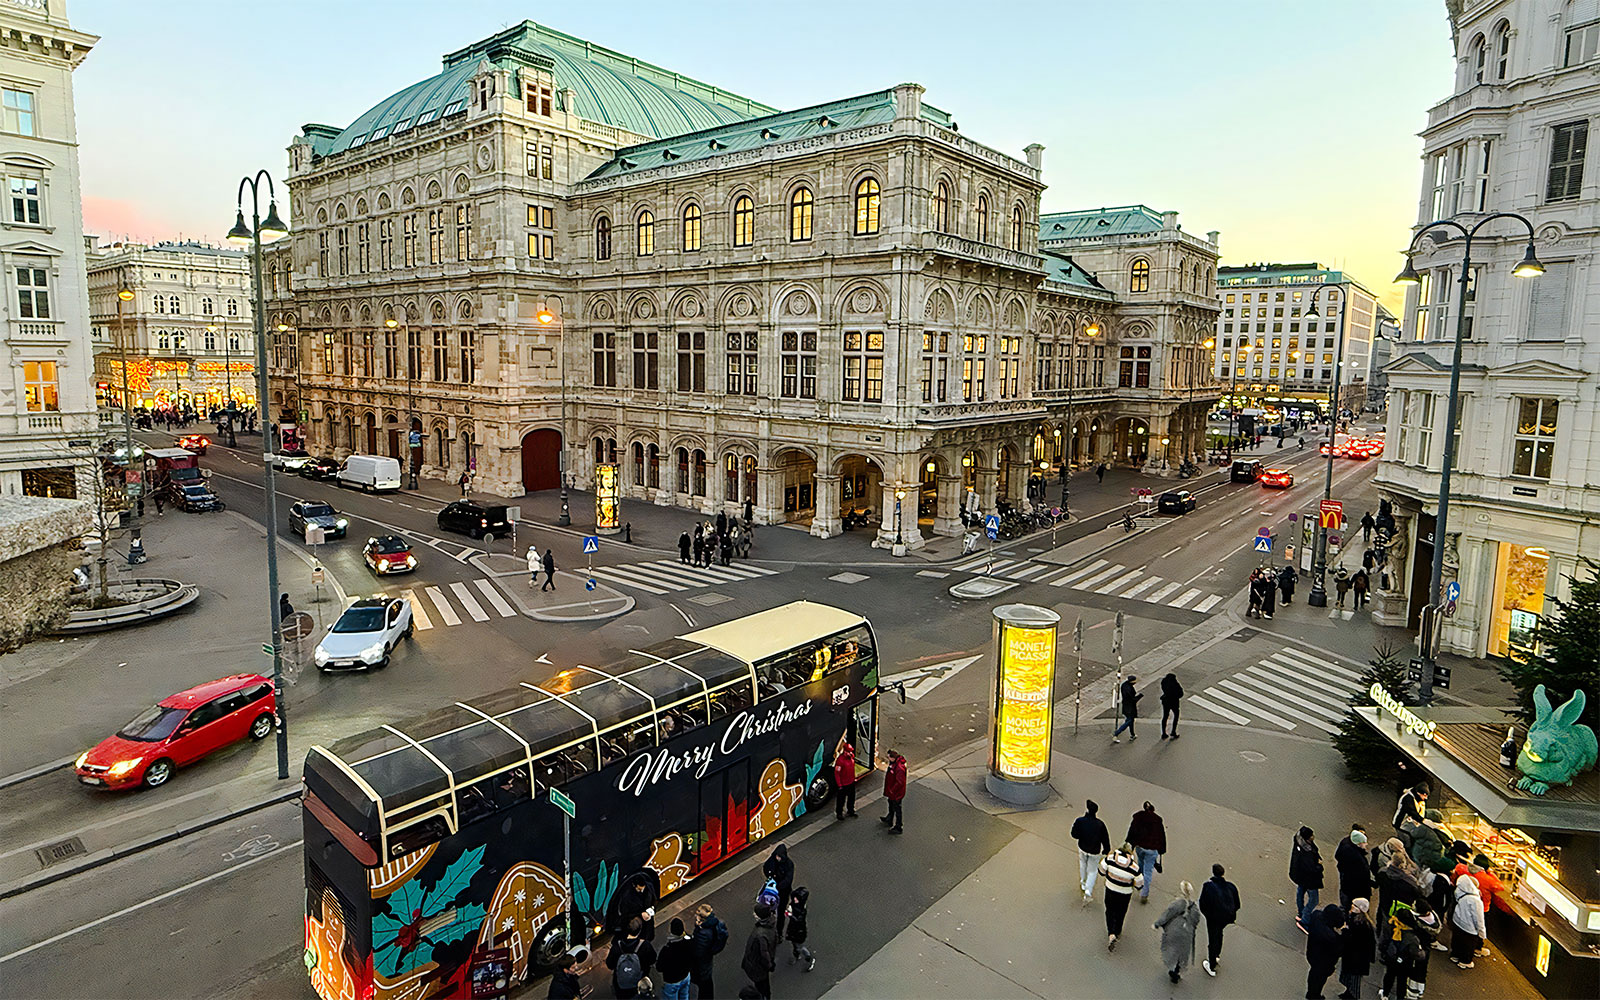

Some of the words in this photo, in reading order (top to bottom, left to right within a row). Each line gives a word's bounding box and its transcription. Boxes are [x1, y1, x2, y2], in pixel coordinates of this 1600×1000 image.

[1010, 640, 1044, 651] MONET
[1010, 648, 1050, 660] PICASSO
[1006, 715, 1040, 728] MONET
[1005, 724, 1046, 737] PICASSO
[618, 739, 717, 796] Merry
[720, 698, 813, 755] Christmas
